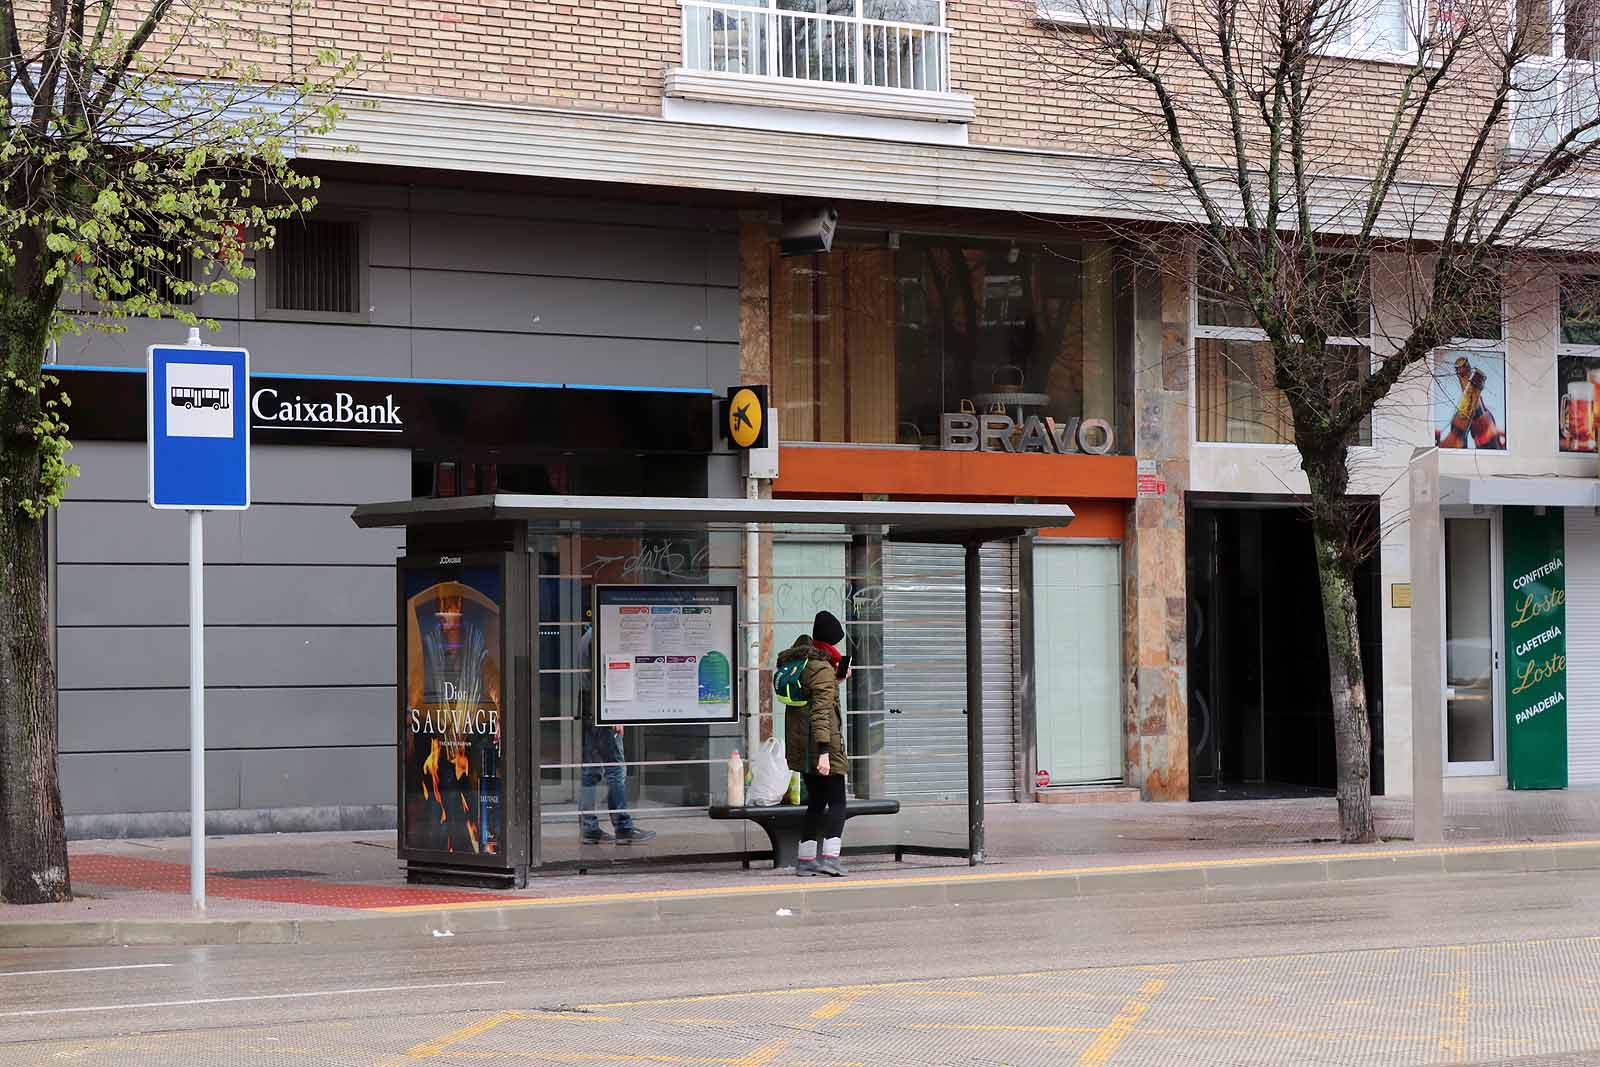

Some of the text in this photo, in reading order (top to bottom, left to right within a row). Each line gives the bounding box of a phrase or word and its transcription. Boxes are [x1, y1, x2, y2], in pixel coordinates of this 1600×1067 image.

[251, 388, 403, 424] CaixaBank
[942, 412, 1114, 455] BRAVO
[1512, 557, 1563, 590] CONFITERÍA
[1511, 586, 1566, 628] Loste
[1515, 625, 1562, 656] CAFETERÍA
[1511, 652, 1566, 695] Loste
[444, 681, 468, 701] Dior
[1515, 691, 1565, 725] PANADERÍA
[411, 708, 498, 735] SAUVAGE
